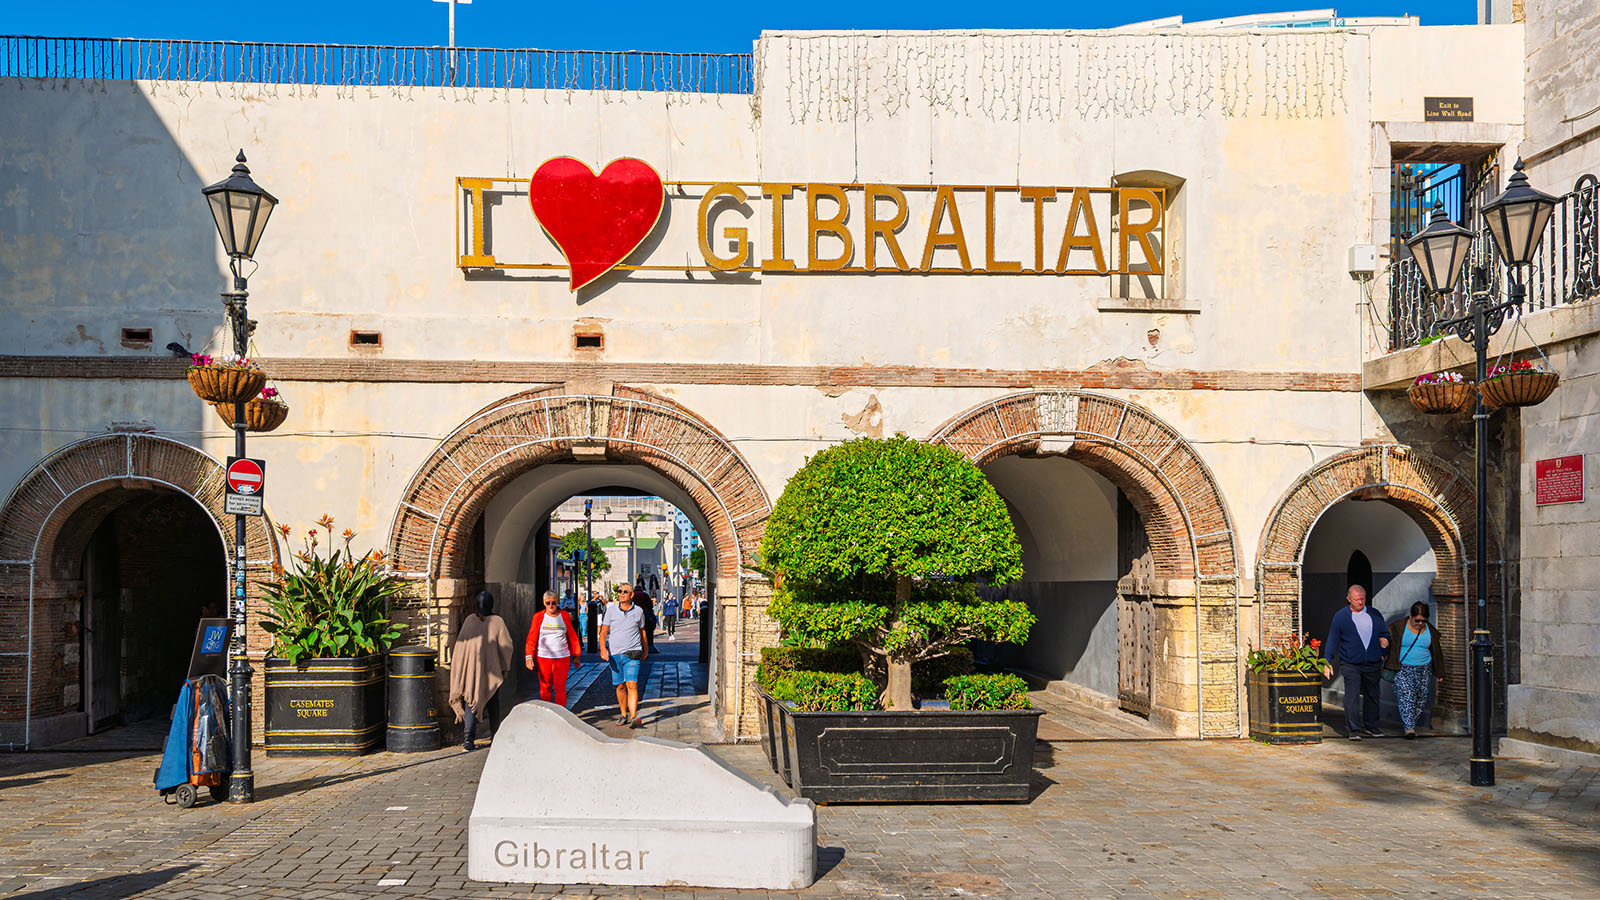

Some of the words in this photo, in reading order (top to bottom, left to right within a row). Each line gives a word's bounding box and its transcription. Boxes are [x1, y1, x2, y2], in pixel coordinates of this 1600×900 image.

[460, 177, 495, 268] I
[697, 182, 1163, 275] GIBRALTAR
[208, 630, 223, 640] JW
[290, 700, 334, 708] CASEMATES
[1279, 696, 1318, 704] CASEMATES
[296, 709, 327, 718] SQUARE
[1286, 705, 1313, 714] SQUARE
[494, 840, 650, 870] Gibraltar
